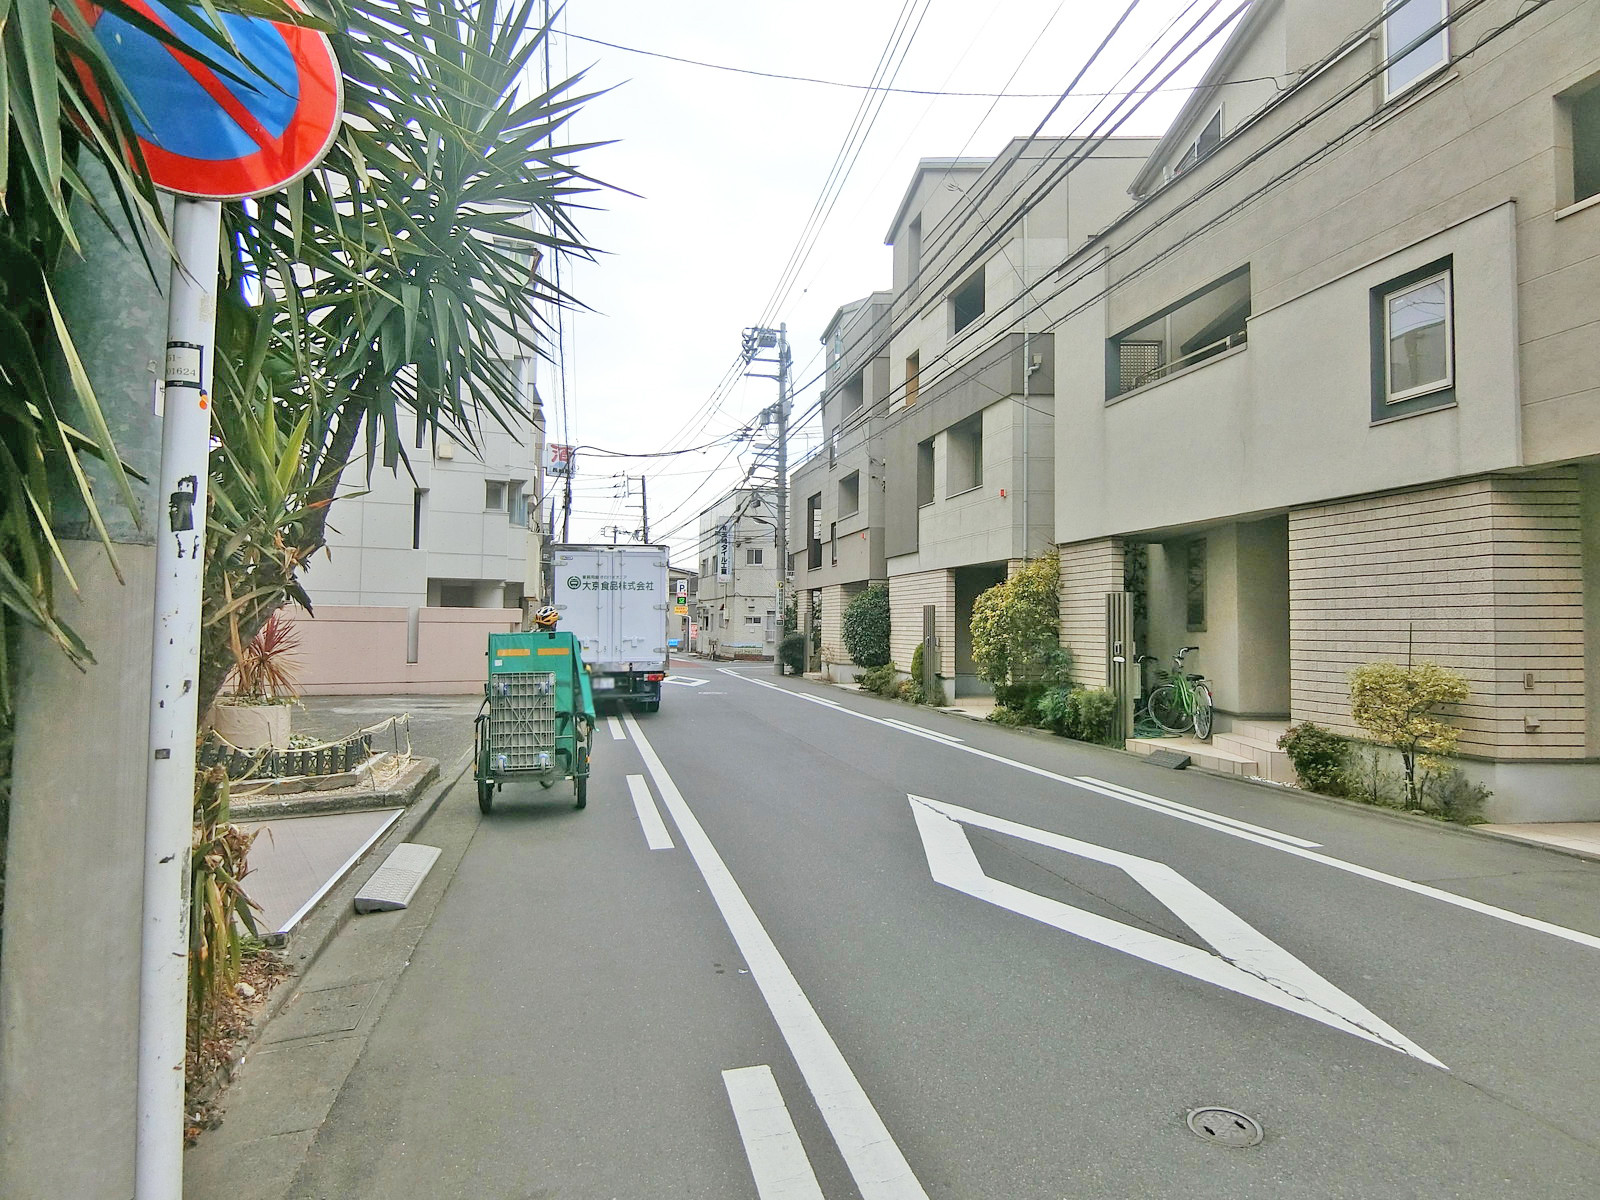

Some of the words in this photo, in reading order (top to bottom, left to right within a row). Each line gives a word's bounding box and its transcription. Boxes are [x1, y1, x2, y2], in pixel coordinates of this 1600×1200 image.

[551, 444, 573, 463] 酒
[582, 581, 654, 591] 大京食品株式会社
